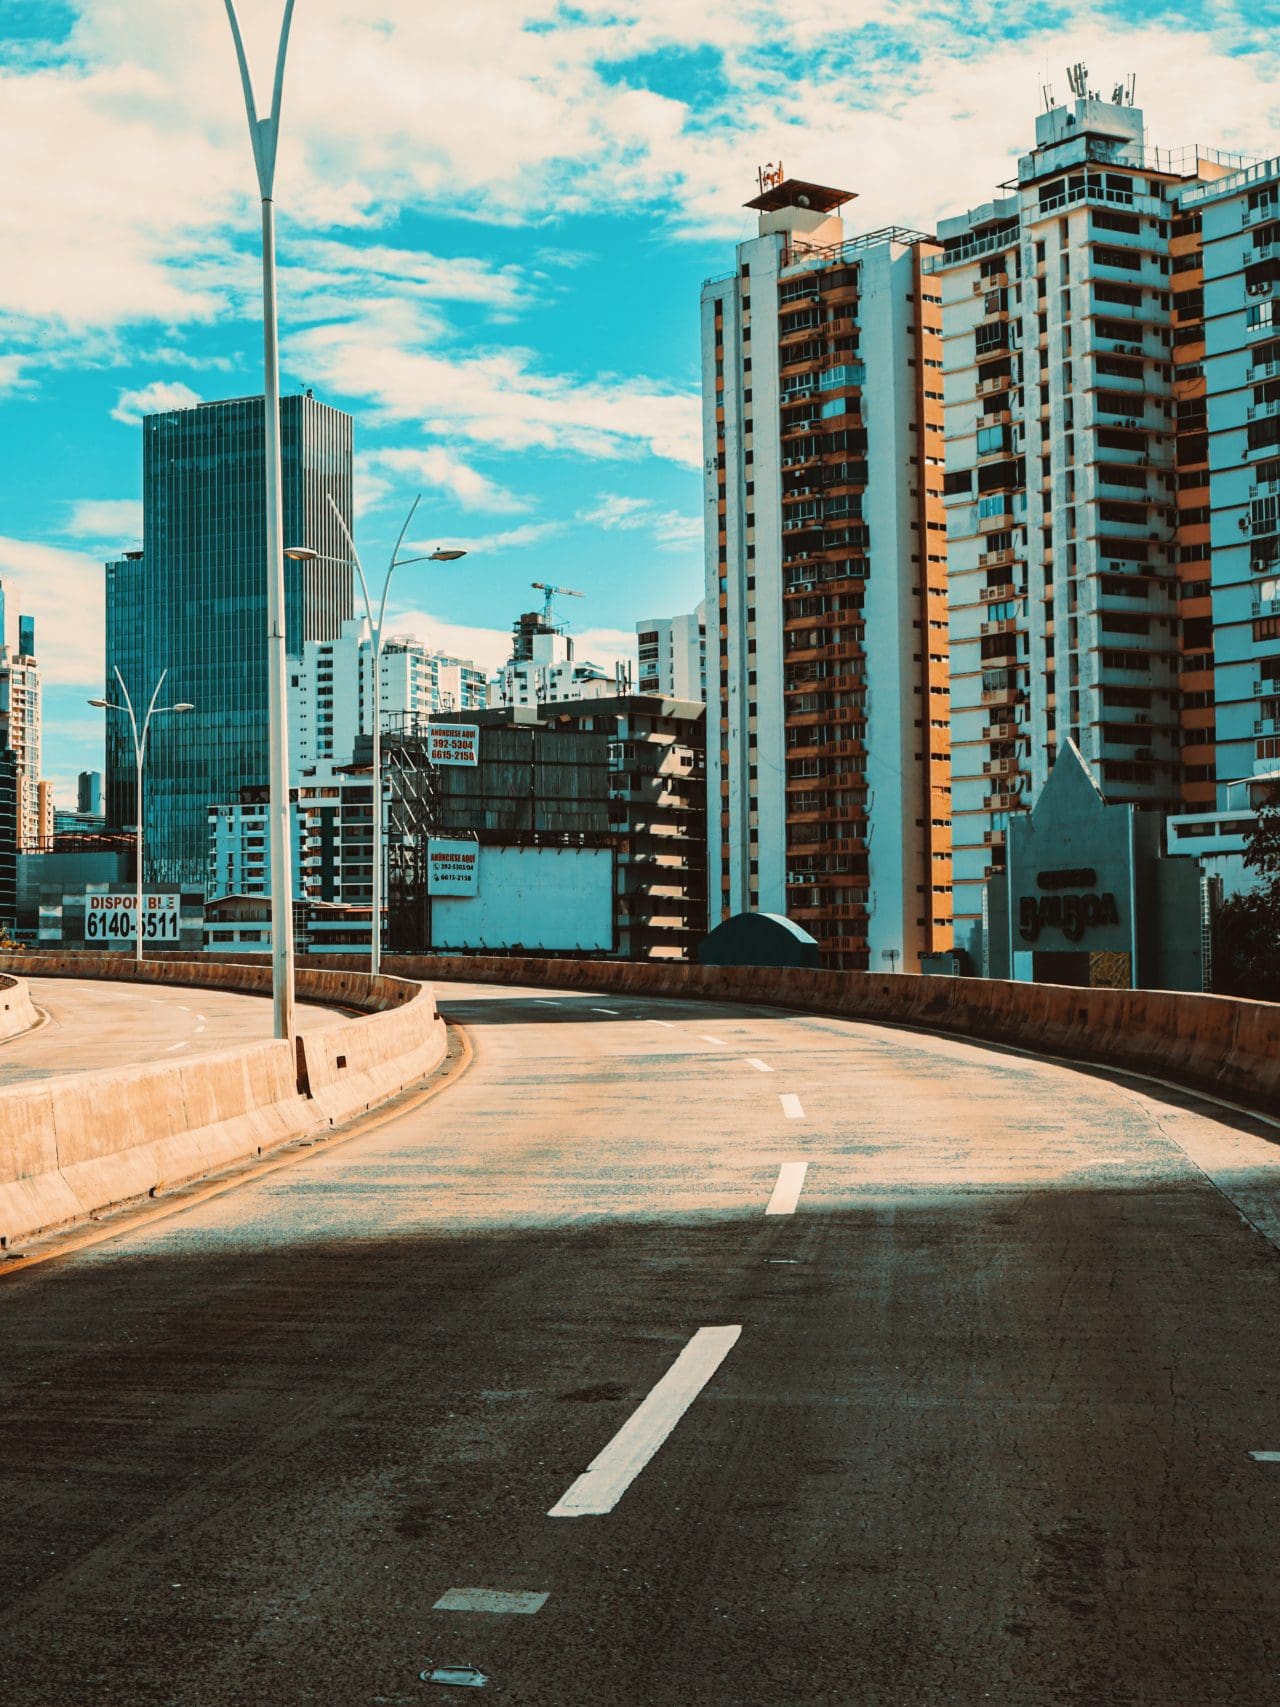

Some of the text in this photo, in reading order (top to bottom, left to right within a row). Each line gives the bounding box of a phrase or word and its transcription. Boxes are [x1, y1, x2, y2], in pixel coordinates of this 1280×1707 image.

[432, 738, 473, 750] 392-5304
[431, 749, 475, 761] 6615-2158
[1019, 892, 1120, 942] BALBOA
